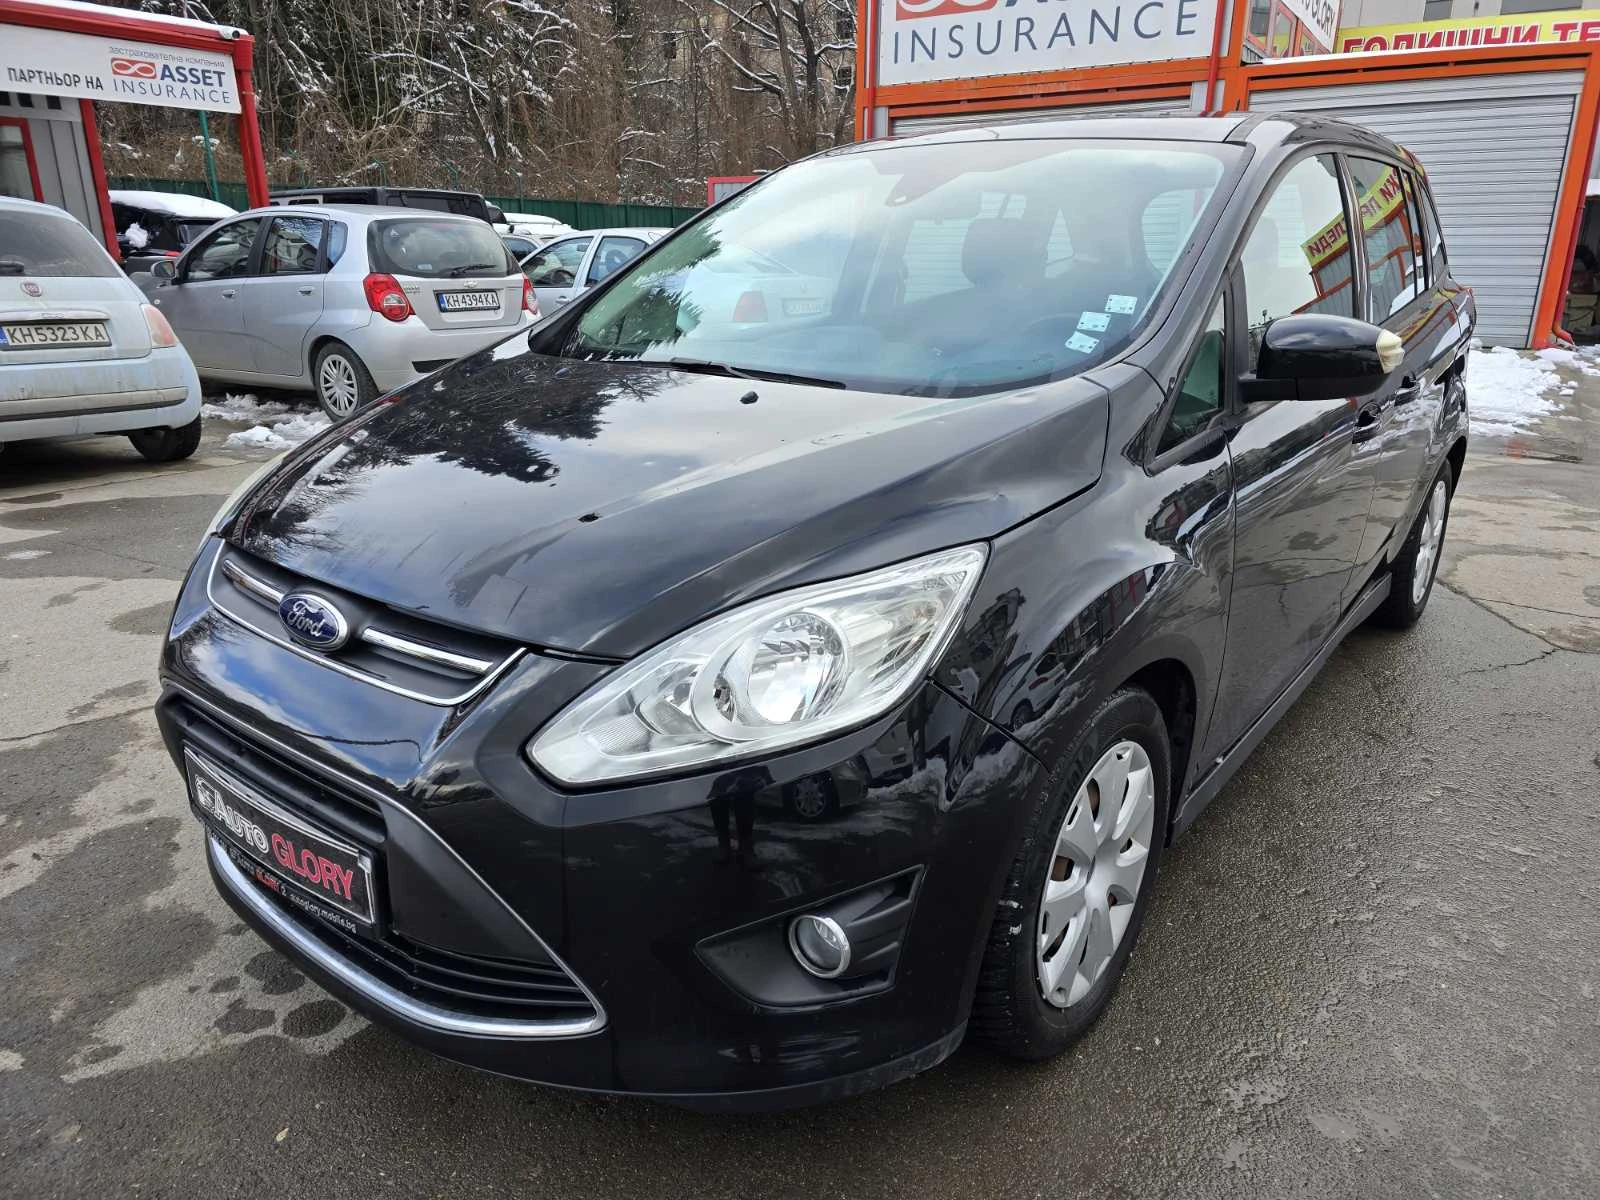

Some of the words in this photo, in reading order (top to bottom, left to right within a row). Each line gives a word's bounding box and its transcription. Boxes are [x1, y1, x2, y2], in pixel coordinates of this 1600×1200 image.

[893, 0, 1198, 64] INSURANCE
[8, 67, 81, 87] ПАРТНЬОР
[86, 77, 104, 91] НА
[113, 78, 231, 104] INSURANCE
[160, 64, 226, 87] ASSET
[287, 600, 324, 637] Ford
[272, 833, 354, 900] GLORY
